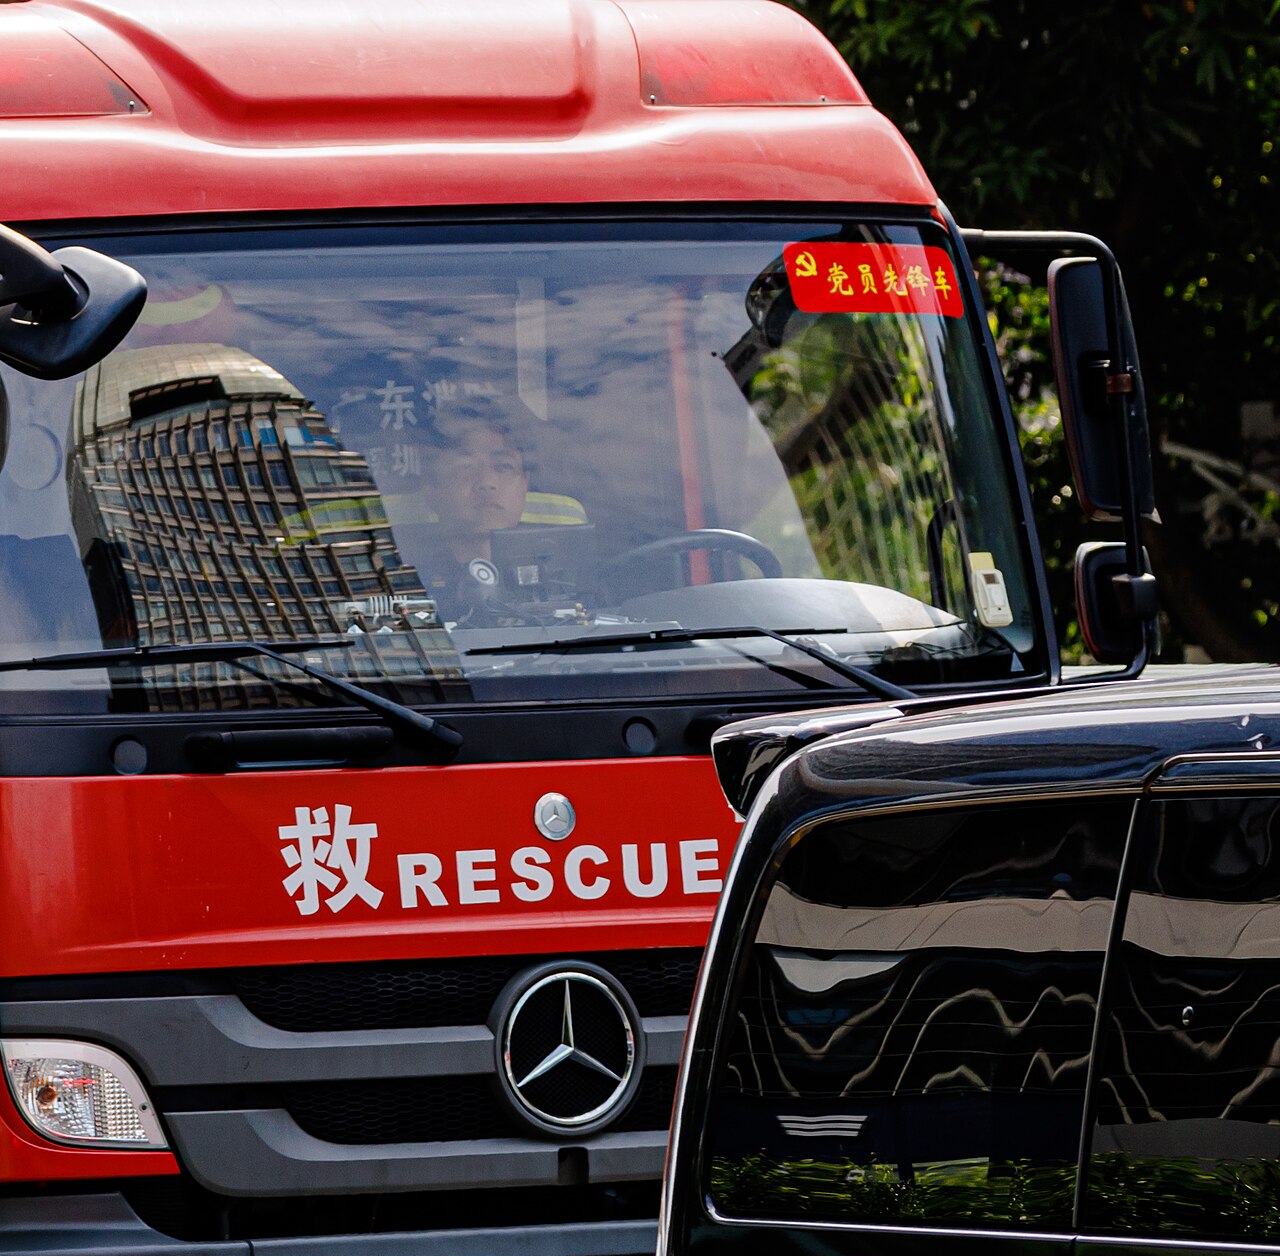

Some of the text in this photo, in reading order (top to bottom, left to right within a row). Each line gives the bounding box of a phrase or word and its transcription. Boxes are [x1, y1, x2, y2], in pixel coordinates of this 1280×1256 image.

[827, 262, 952, 300] 党员先锋车
[277, 803, 724, 917] 救 RESCUE
